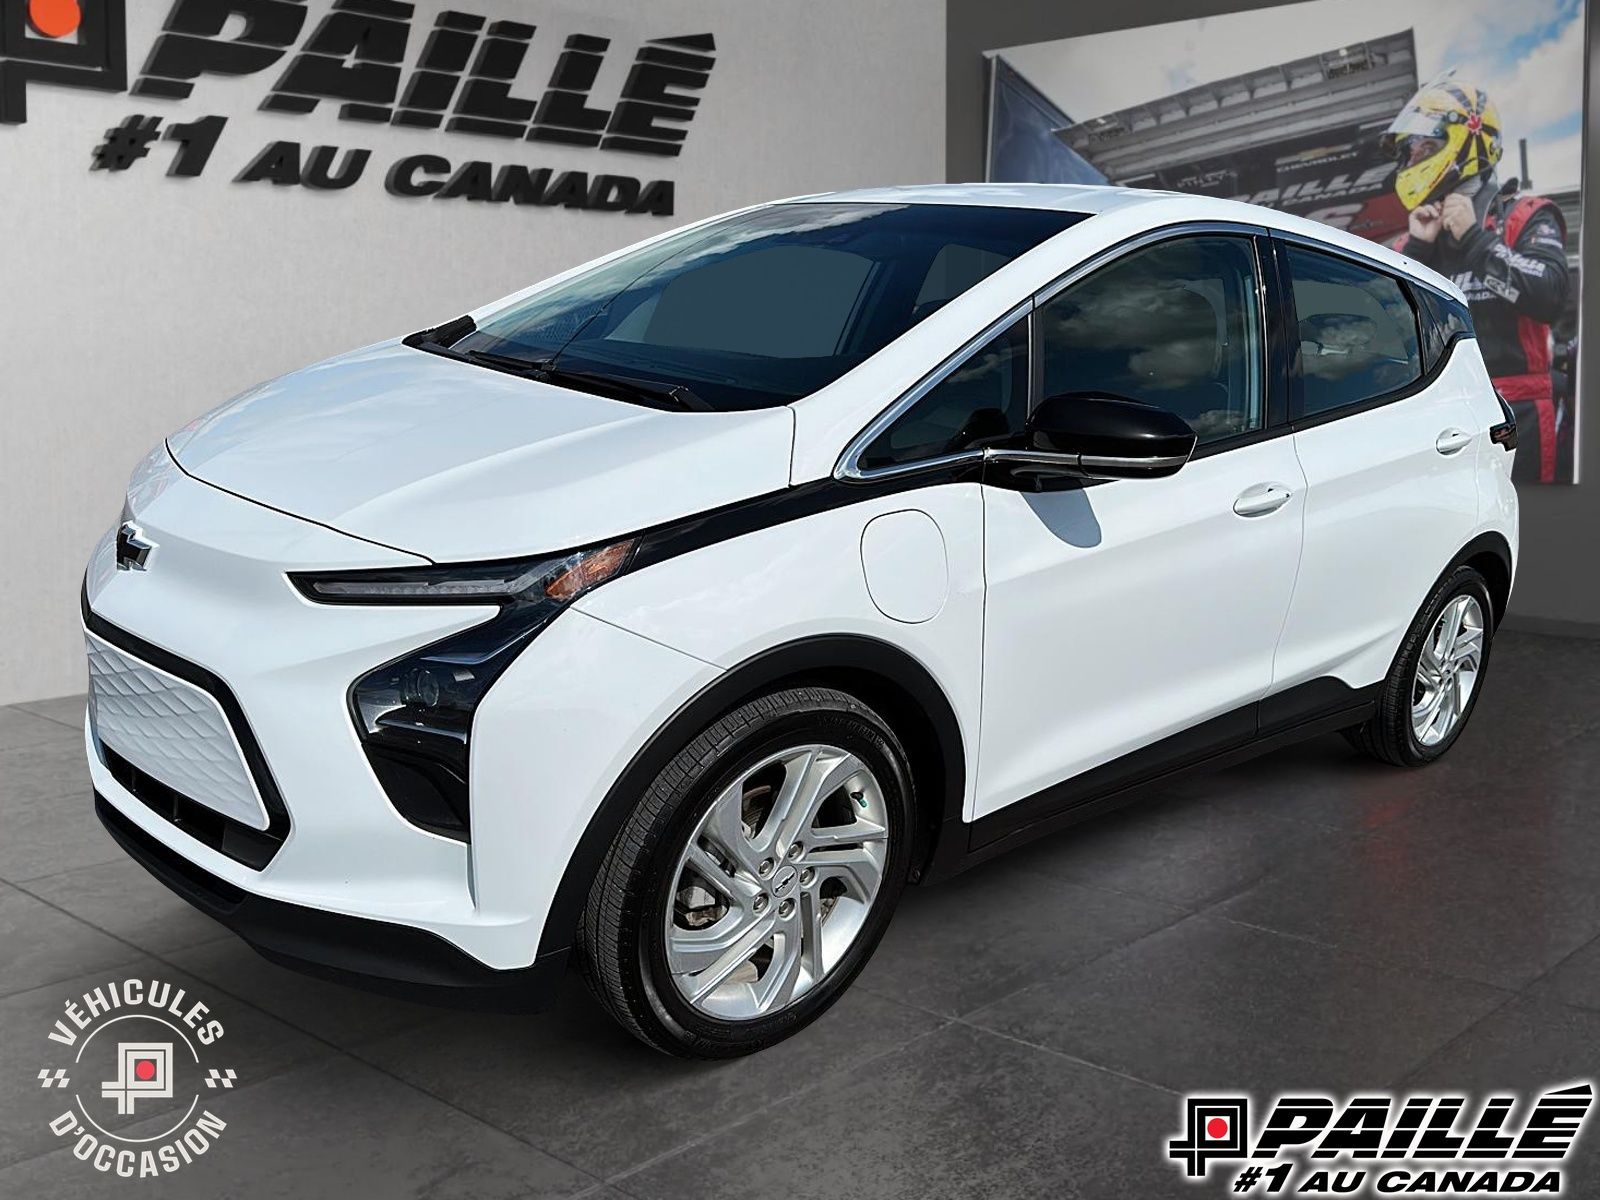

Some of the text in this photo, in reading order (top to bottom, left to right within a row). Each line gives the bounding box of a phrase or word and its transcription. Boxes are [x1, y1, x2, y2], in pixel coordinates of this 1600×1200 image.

[129, 0, 716, 157] PAILLÉ
[90, 114, 675, 217] #1 AU CANADA
